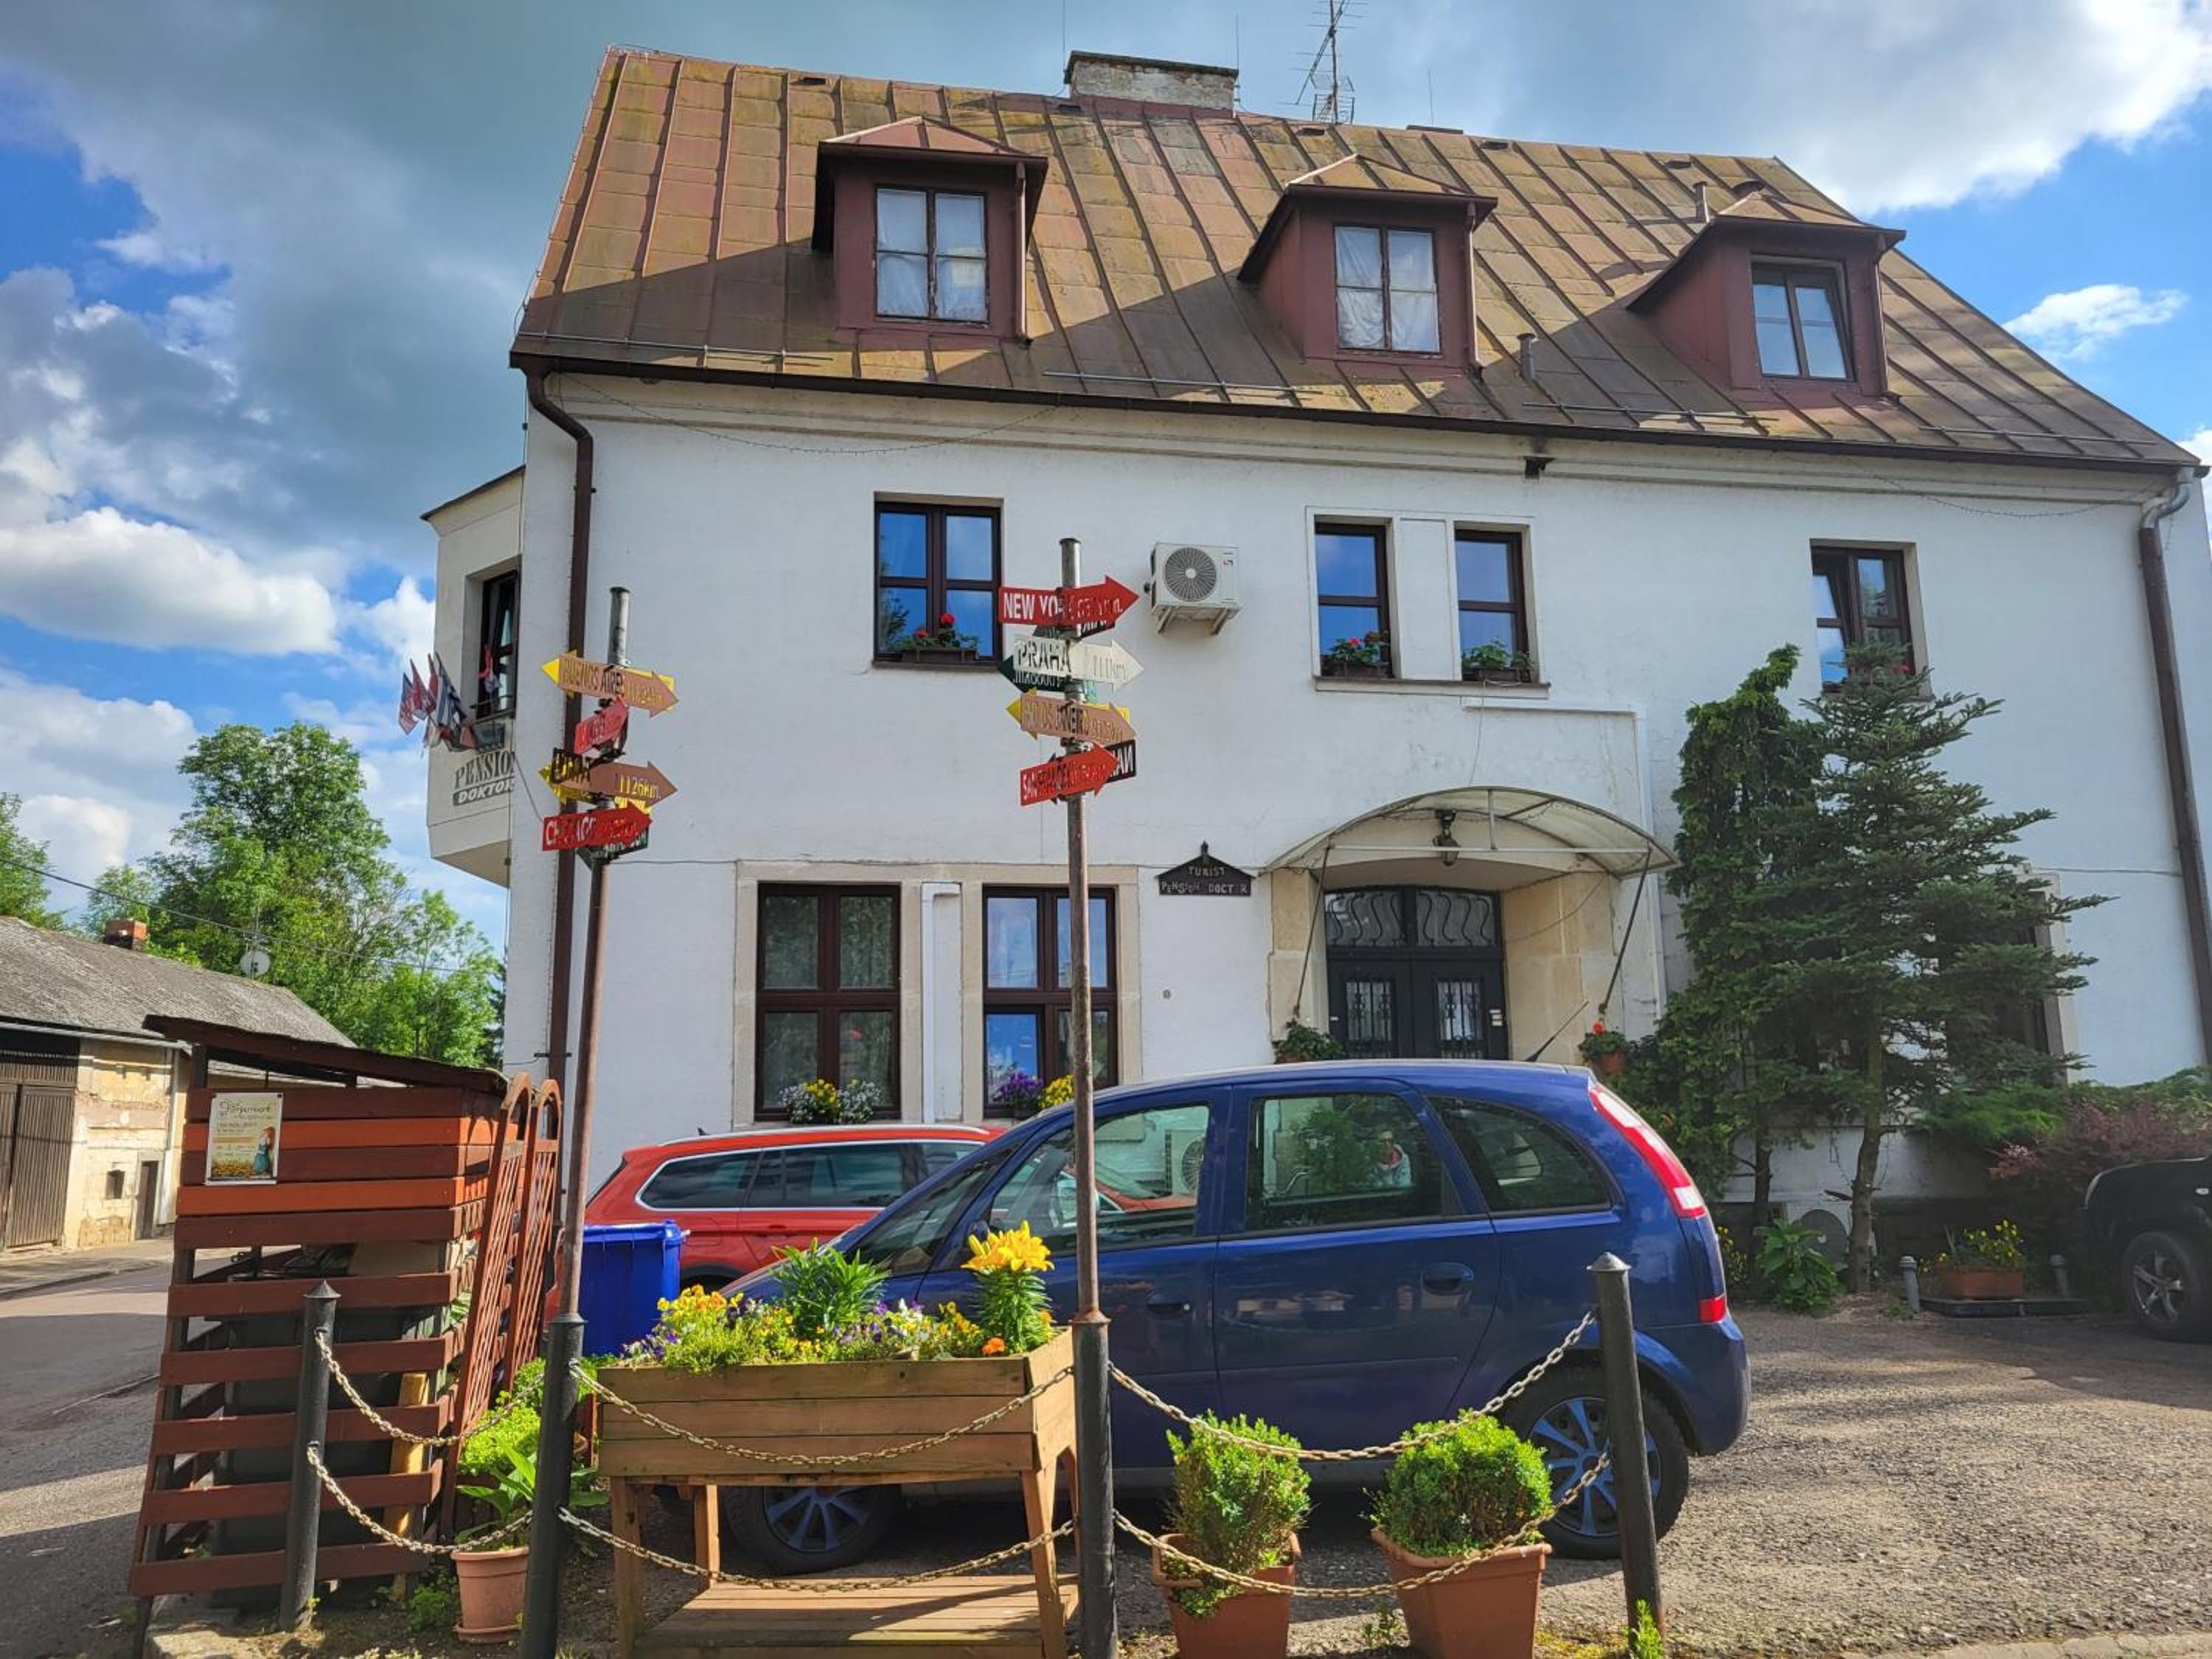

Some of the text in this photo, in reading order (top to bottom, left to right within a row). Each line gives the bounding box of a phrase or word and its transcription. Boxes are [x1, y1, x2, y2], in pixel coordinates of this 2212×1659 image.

[1004, 593, 1034, 619] NEW
[1018, 637, 1071, 672] PRAHA
[563, 658, 599, 690] BUENOS
[1188, 866, 1225, 877] TURIST
